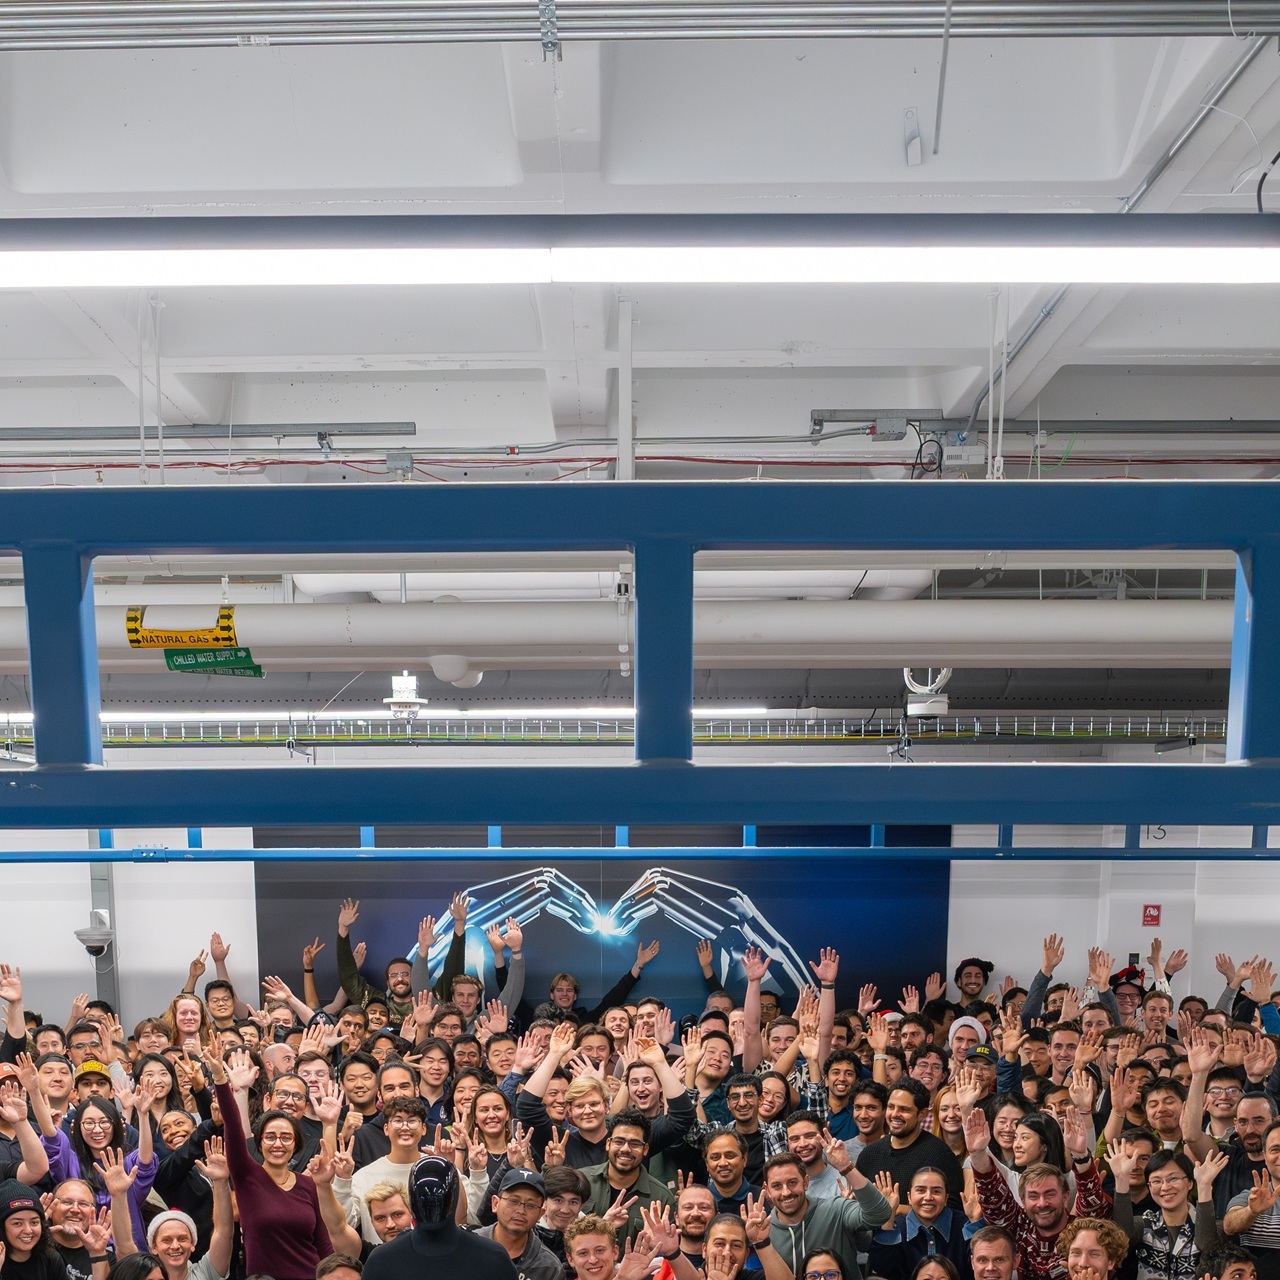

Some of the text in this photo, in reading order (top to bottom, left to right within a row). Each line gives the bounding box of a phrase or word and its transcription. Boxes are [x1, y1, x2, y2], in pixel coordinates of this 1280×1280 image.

[141, 635, 210, 644] NATURAL GAS
[173, 650, 236, 665] CHILLED WATER SUPPLY
[234, 668, 255, 676] RETURN
